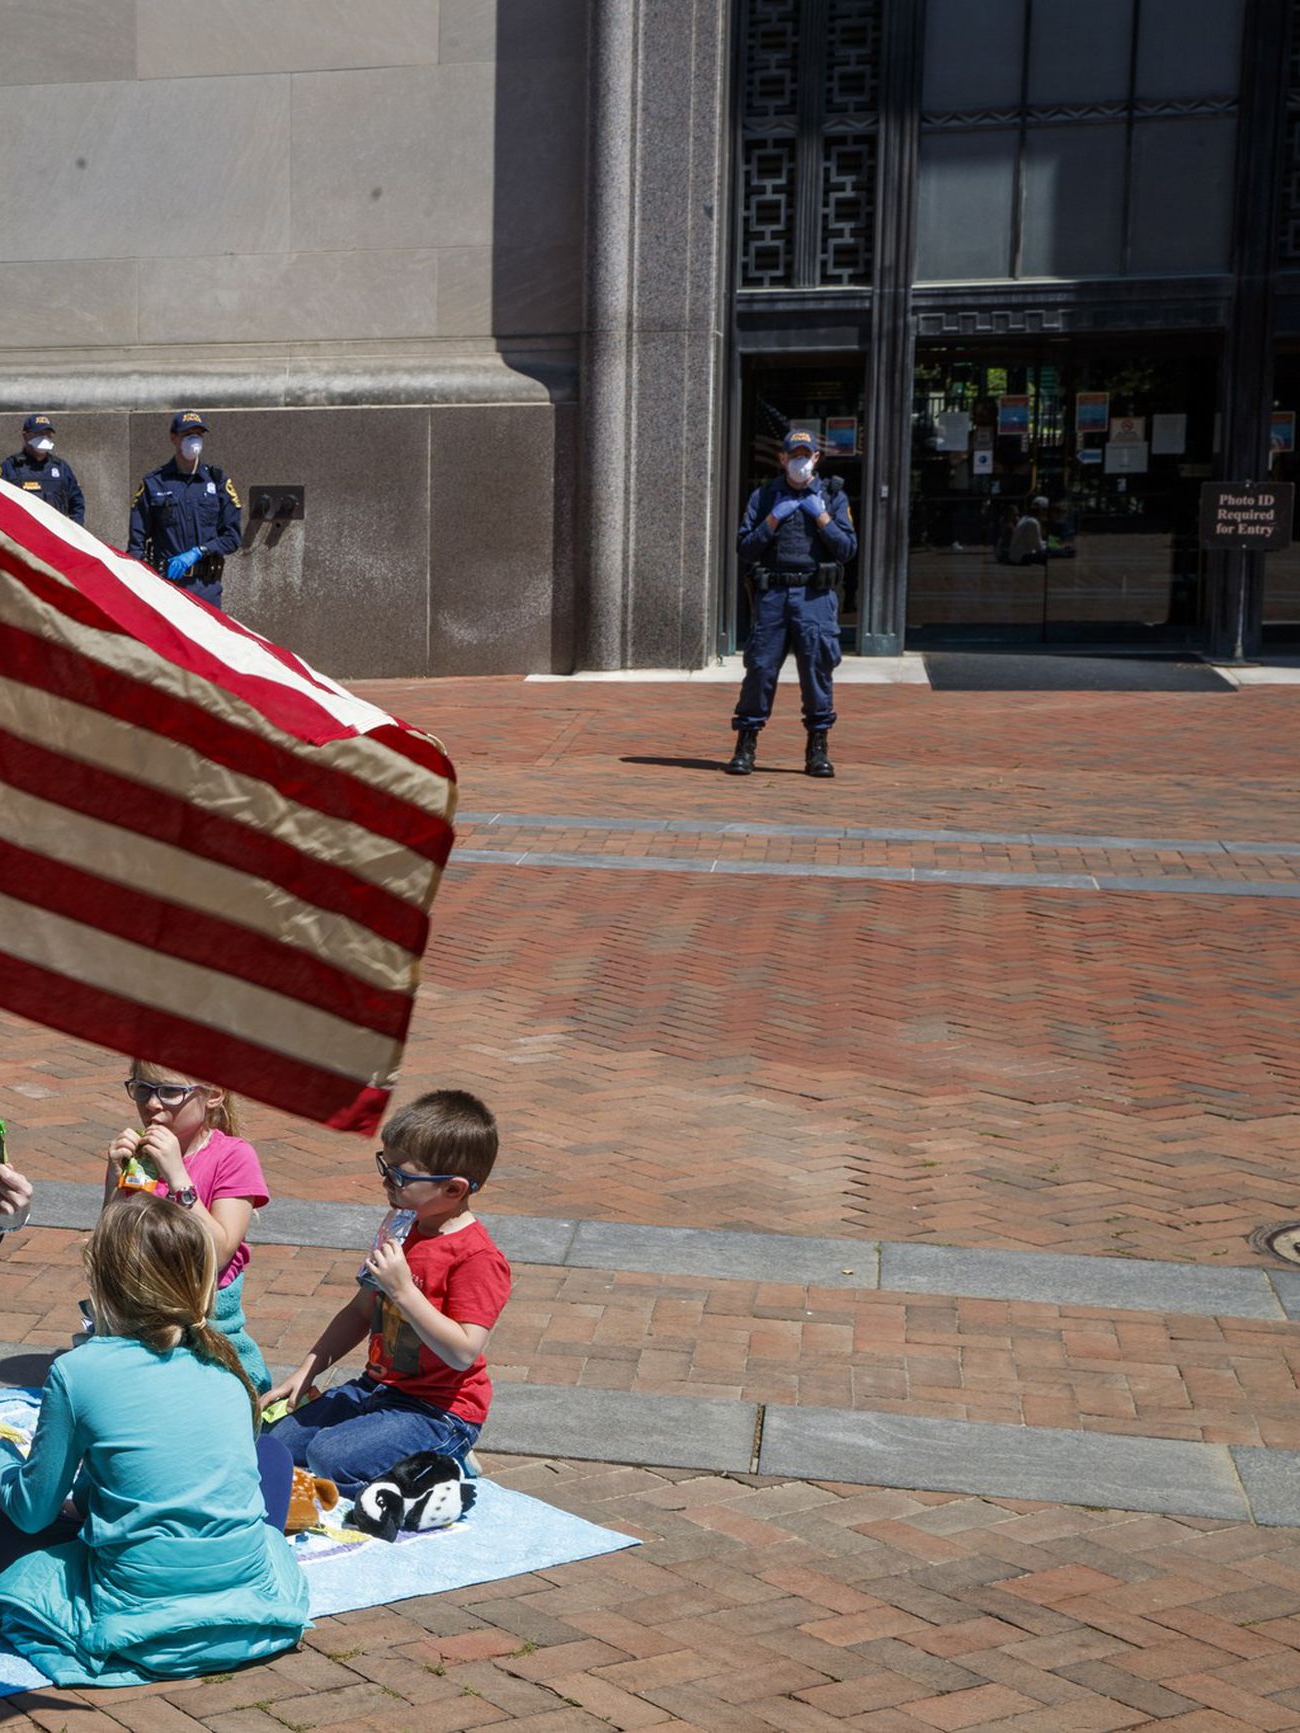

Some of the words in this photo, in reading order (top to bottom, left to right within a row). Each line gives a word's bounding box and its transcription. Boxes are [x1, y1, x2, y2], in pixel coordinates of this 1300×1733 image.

[1219, 494, 1255, 506] Photo
[1258, 494, 1275, 506] ID
[1217, 509, 1275, 522] Required
[1216, 523, 1236, 535] for
[1238, 523, 1274, 537] Entry
